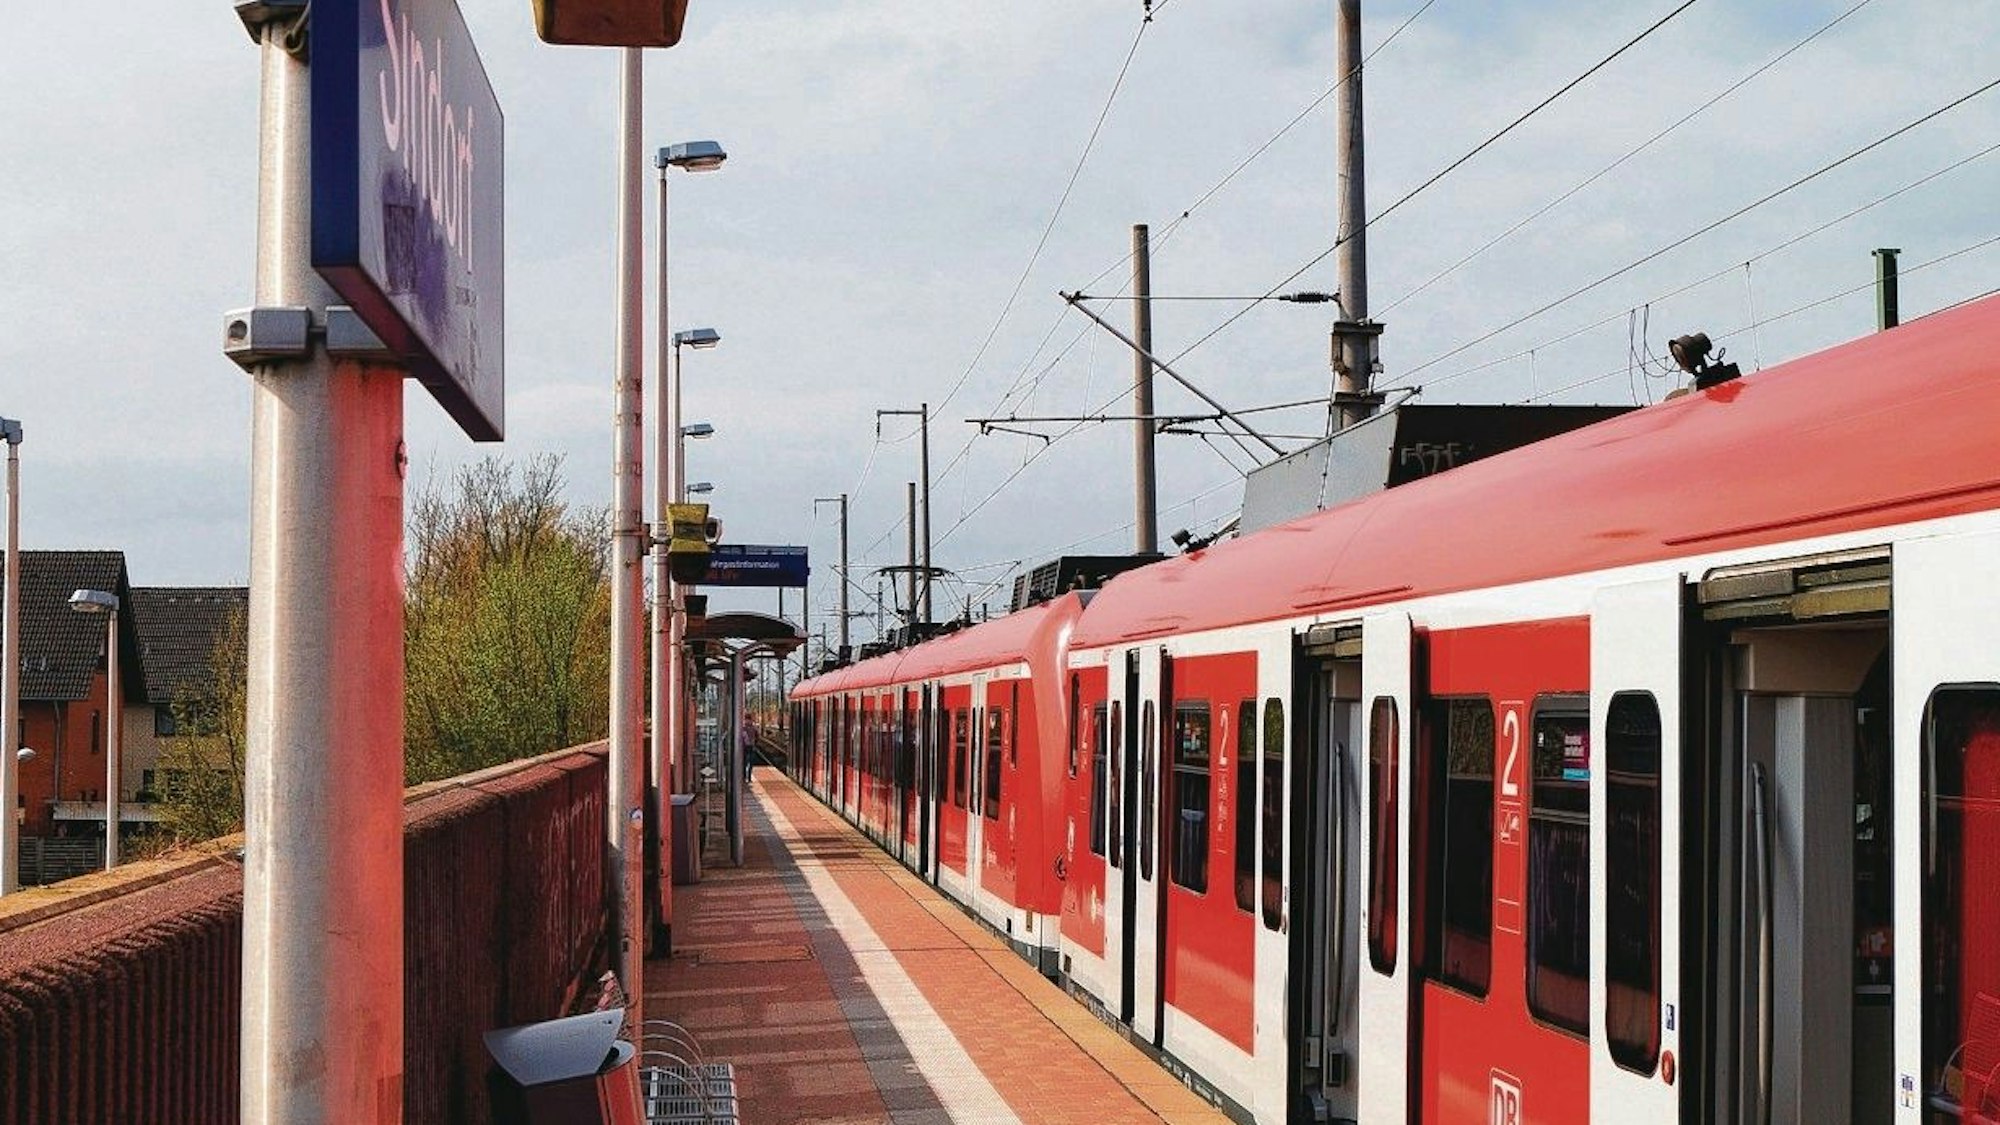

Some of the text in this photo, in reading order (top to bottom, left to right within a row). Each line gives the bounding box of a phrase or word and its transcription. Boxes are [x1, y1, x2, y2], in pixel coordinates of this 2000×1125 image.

[1081, 707, 1089, 750] 2
[1218, 709, 1229, 766] 2
[1501, 709, 1520, 796] 2
